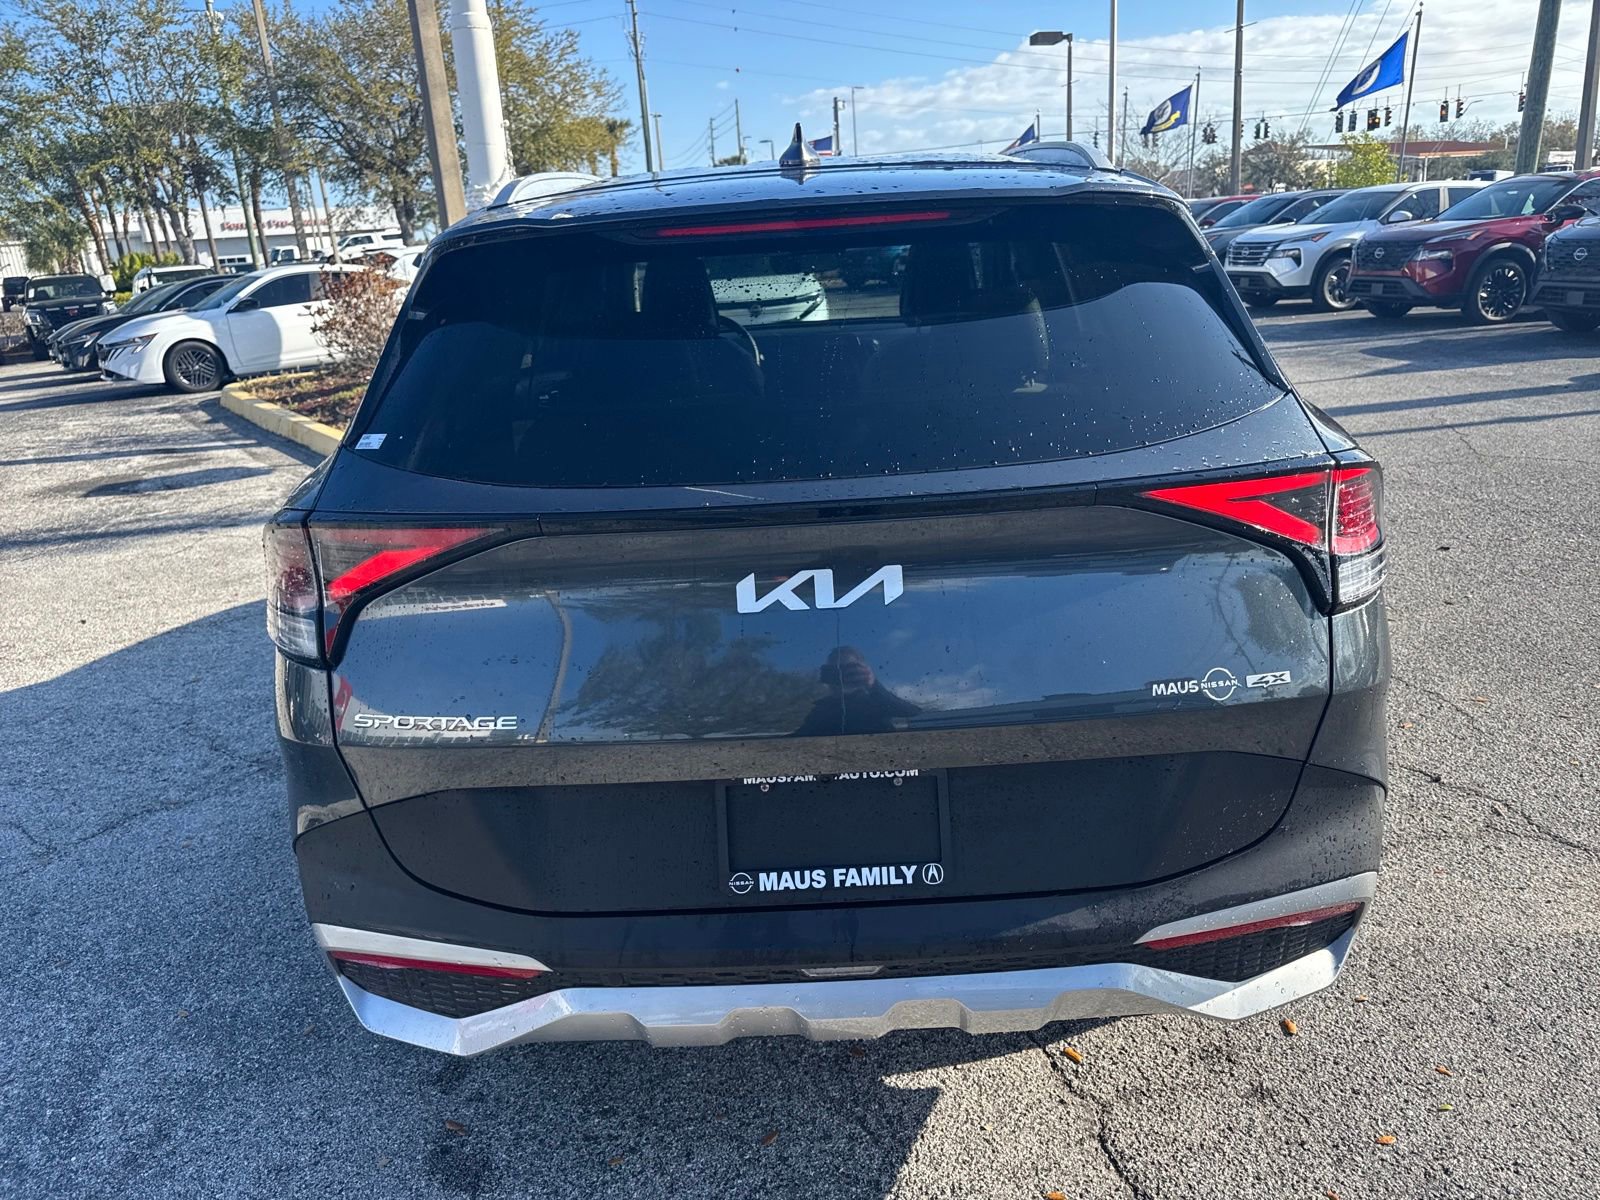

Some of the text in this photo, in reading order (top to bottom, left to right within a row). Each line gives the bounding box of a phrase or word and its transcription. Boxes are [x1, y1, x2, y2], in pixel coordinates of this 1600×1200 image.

[736, 564, 904, 614] KIA
[1152, 679, 1238, 697] MAUS NISSAN
[353, 713, 518, 731] SPORTAGE
[758, 865, 918, 891] MAUS FAMILY
